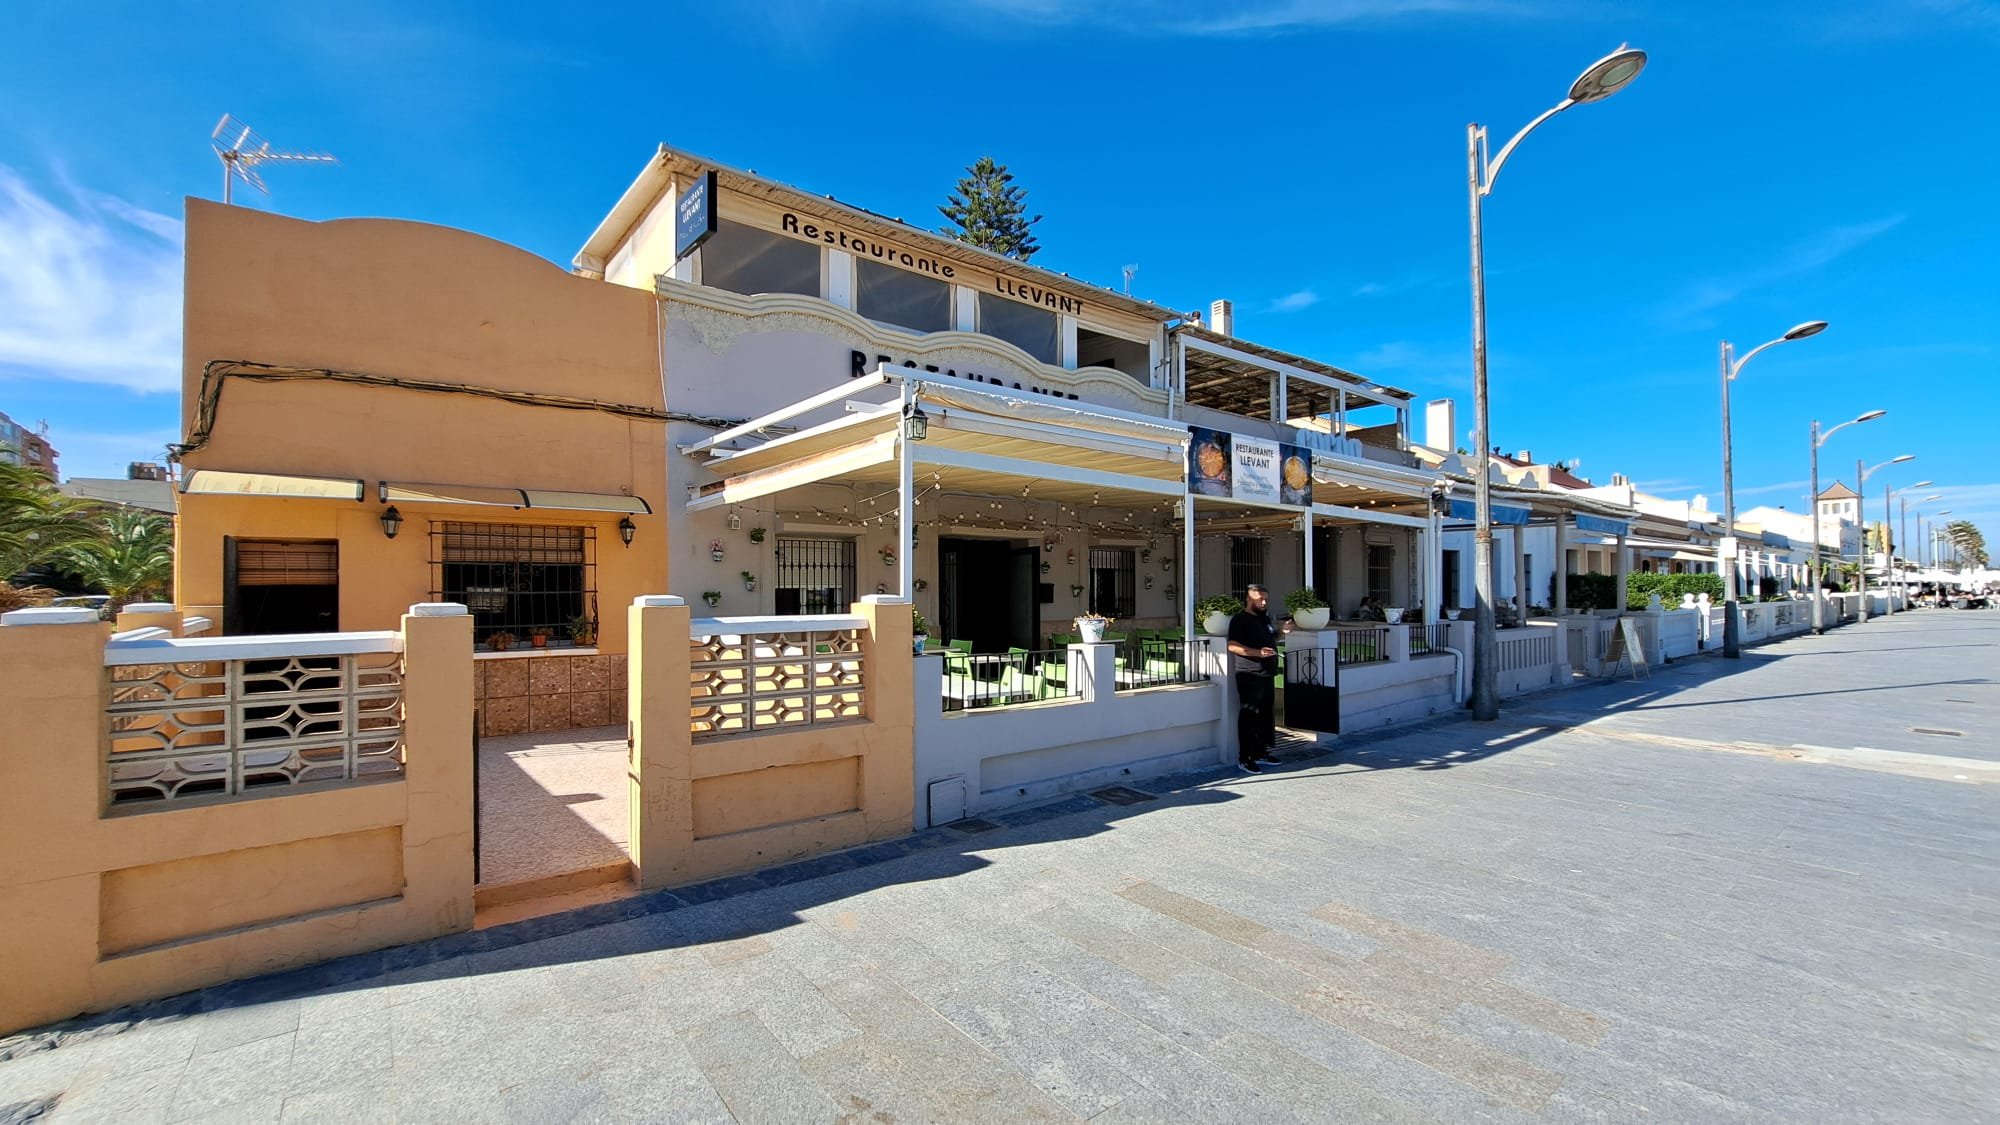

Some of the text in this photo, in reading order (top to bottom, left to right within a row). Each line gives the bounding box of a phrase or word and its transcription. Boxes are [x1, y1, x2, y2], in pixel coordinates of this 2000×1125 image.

[782, 213, 1083, 315] Restaurante LLEVANT
[1235, 444, 1274, 458] RESTAURANTE
[1240, 456, 1270, 469] LLEVANT
